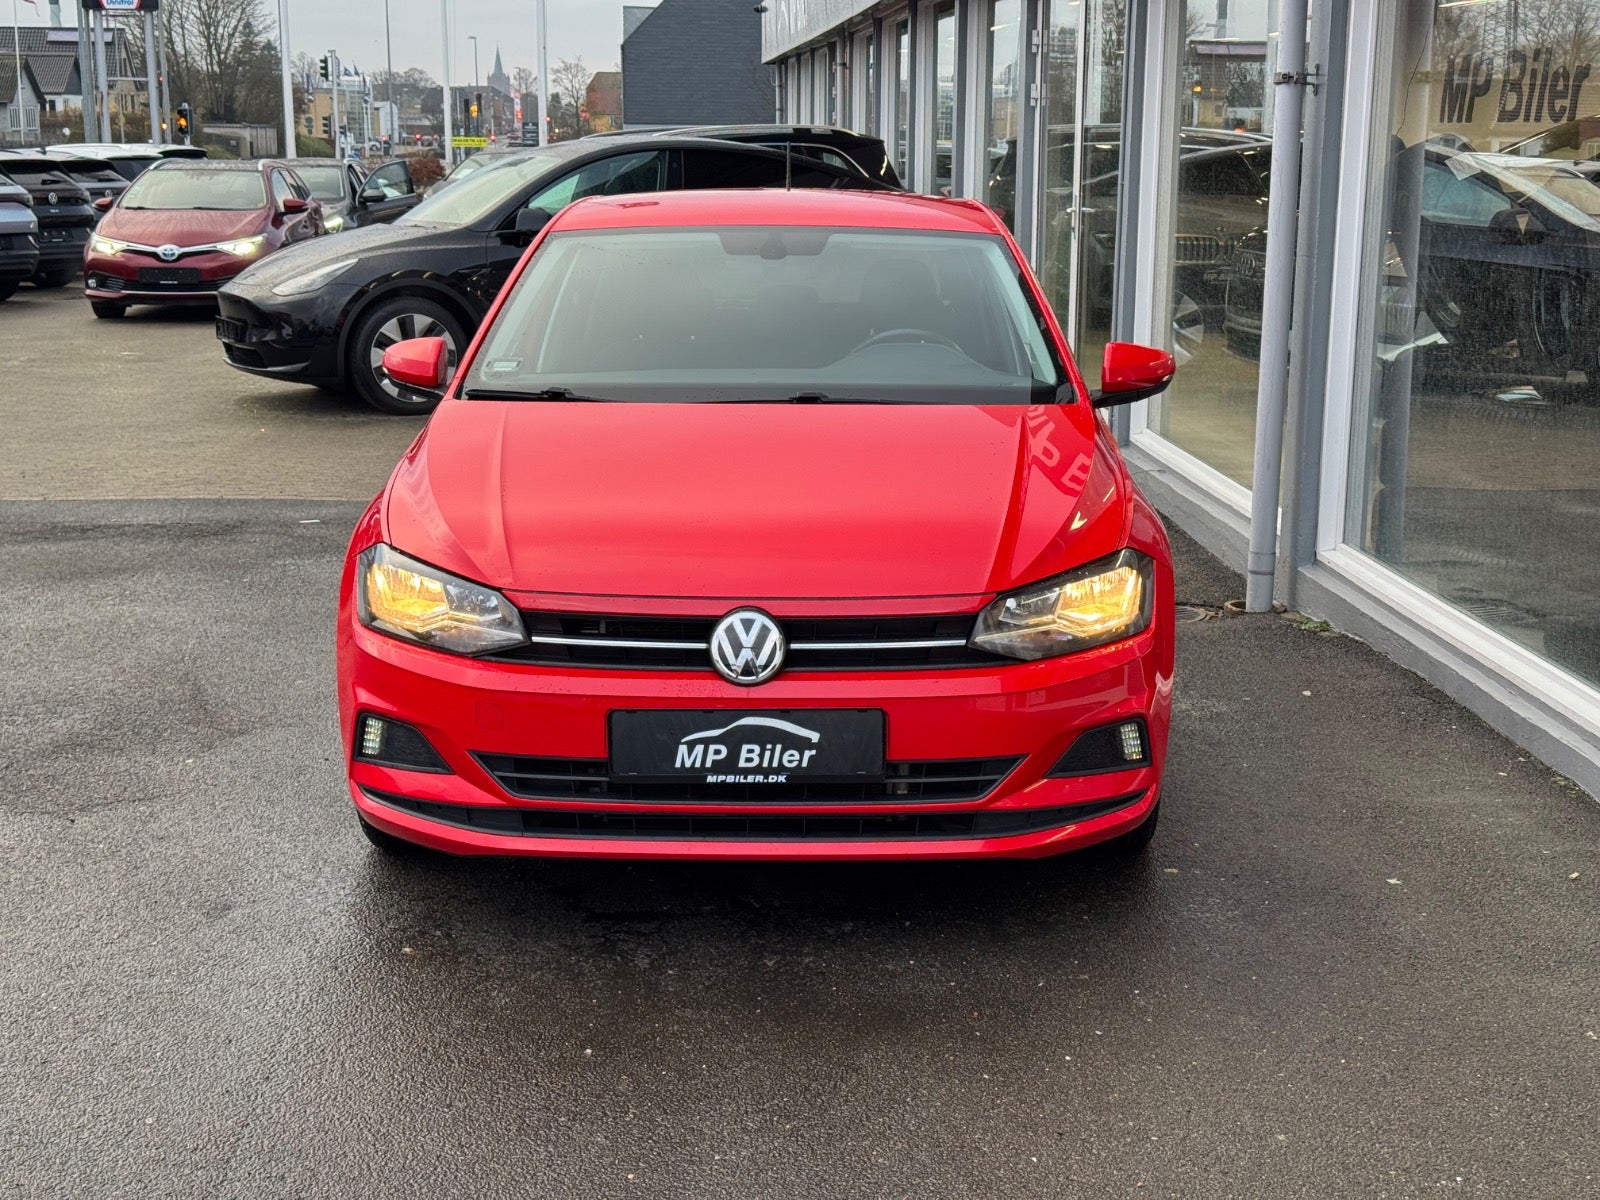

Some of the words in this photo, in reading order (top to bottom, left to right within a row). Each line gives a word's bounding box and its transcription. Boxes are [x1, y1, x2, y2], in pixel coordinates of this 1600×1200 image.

[1439, 53, 1494, 124] MP
[1496, 46, 1592, 124] Biler
[674, 744, 727, 768] MP
[738, 744, 816, 768] Biler
[706, 775, 787, 783] MPBILER.DK
